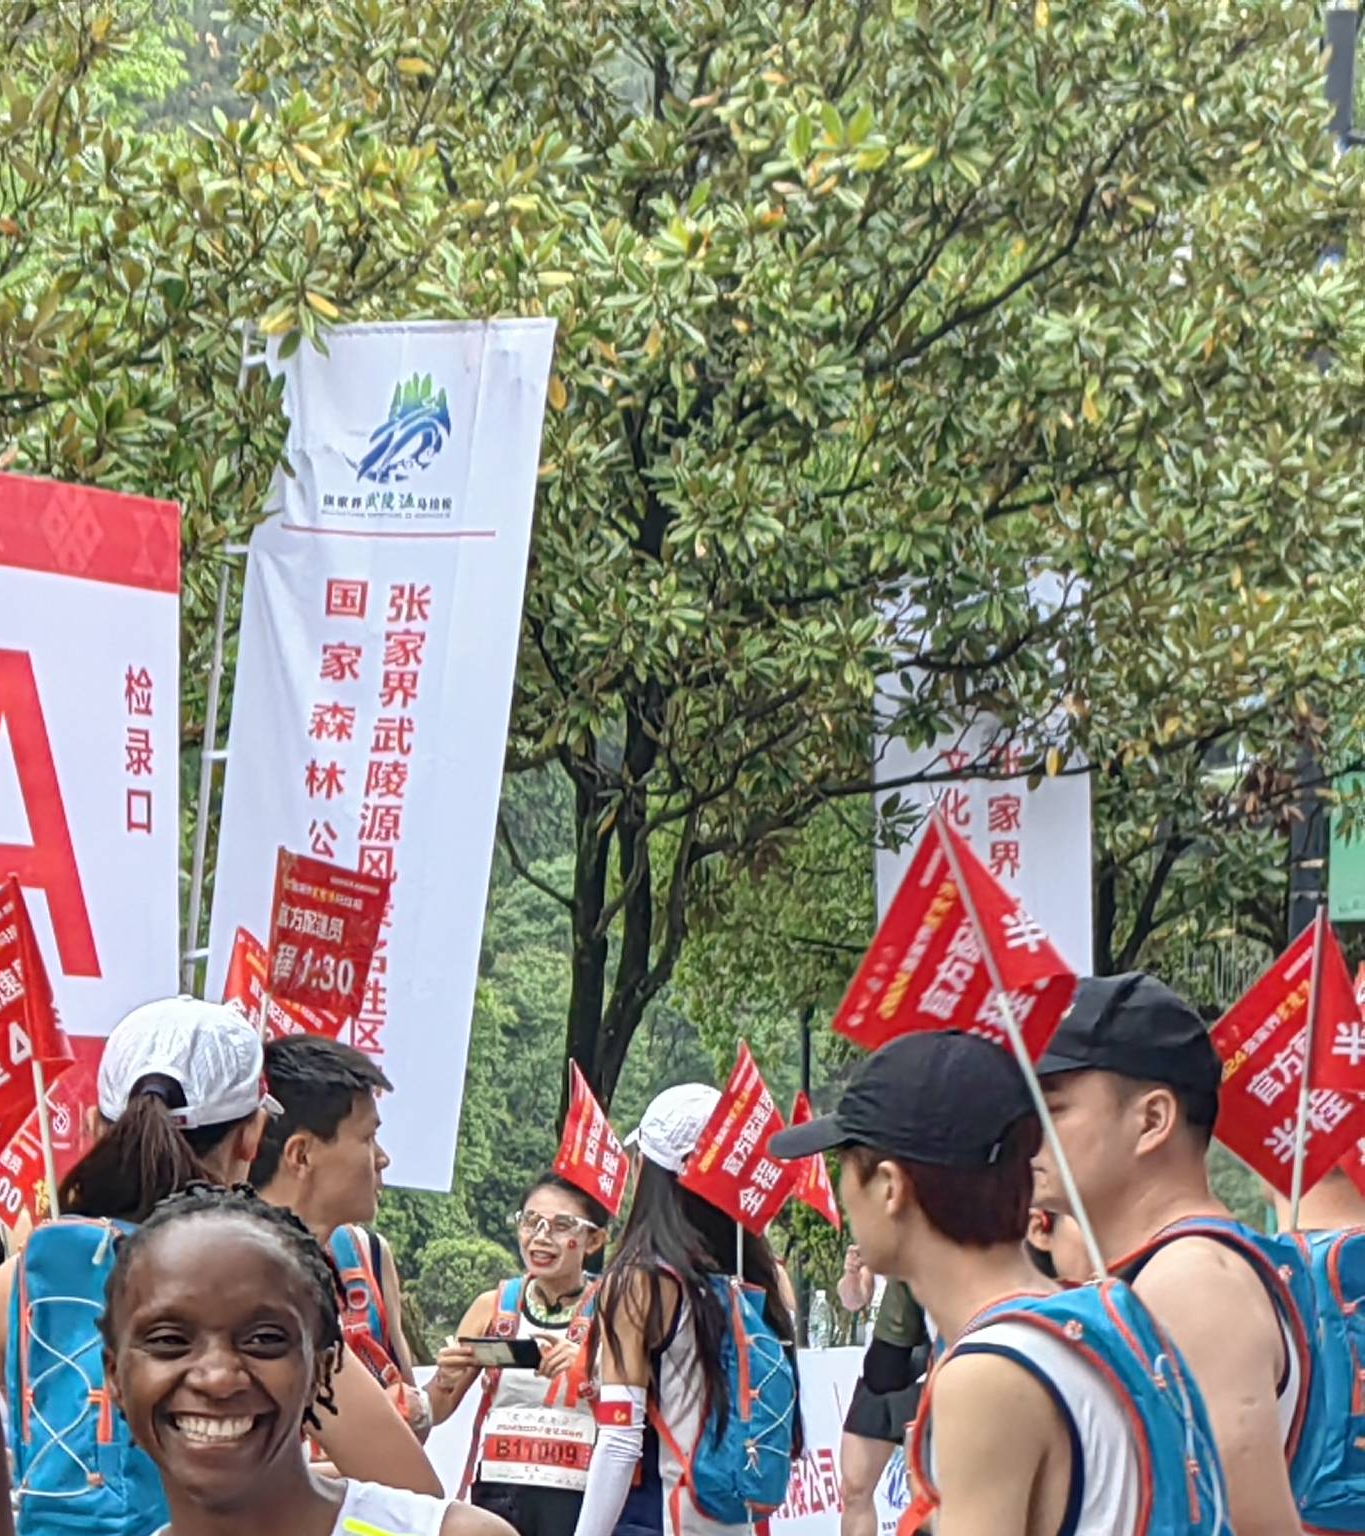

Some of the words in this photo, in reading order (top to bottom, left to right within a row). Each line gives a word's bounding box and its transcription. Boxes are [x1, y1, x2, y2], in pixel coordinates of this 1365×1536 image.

[124, 666, 155, 836] 检录口
[299, 946, 355, 996] 1:30
[737, 1158, 783, 1217] 全程
